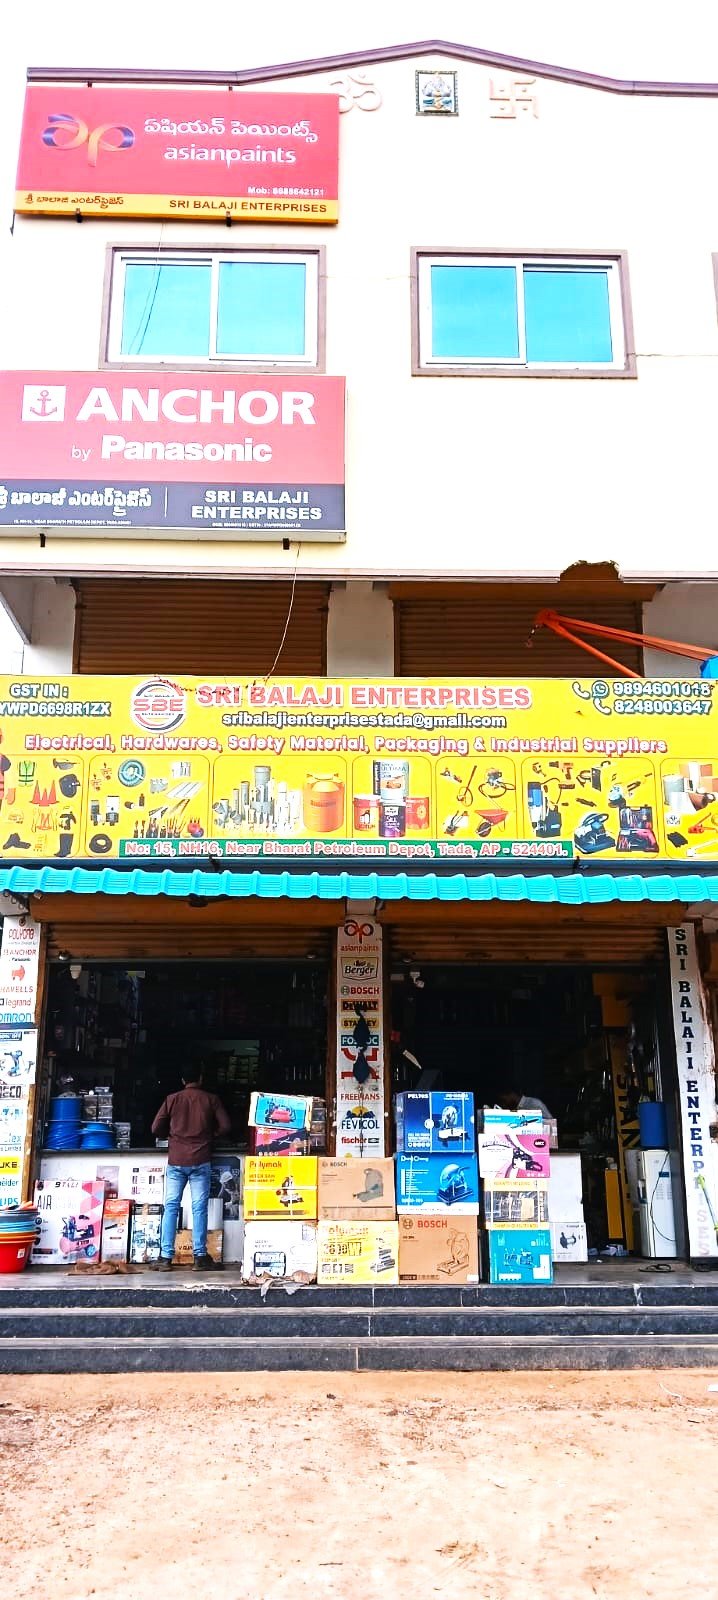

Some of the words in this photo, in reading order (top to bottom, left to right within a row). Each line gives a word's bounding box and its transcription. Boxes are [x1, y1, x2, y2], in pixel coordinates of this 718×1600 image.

[144, 117, 225, 136] ఏషియన్
[164, 143, 297, 168] asianpaints
[247, 186, 270, 195] Mob:
[169, 199, 190, 209] SRI
[193, 200, 238, 210] BALAJI
[241, 201, 327, 212] ENTERPRISES
[76, 387, 316, 425] ANCHOR
[70, 445, 92, 462] by
[100, 434, 273, 462] Panasonic
[204, 490, 236, 503] SRI
[242, 491, 309, 504] BALAJI
[191, 505, 322, 520] ENTERPRISES
[10, 683, 41, 698] GST
[42, 683, 60, 698] IN
[197, 685, 241, 705] SRI
[249, 686, 342, 706] BALAJI
[350, 686, 531, 707] ENTERPRISES
[133, 698, 184, 712] SBE
[614, 699, 713, 714] 8248003647
[222, 711, 507, 730] sribalajienterprisestada@gmail.com
[24, 734, 116, 753] Electrical,
[120, 734, 223, 753] Hardwares,
[227, 734, 285, 755] Safety
[289, 735, 370, 754] Material,
[374, 735, 469, 756] Packaging
[473, 737, 487, 752] &
[490, 736, 578, 753] Industrial
[582, 737, 668, 757] Suppliers
[125, 841, 149, 855] No:
[154, 841, 175, 857] 15,
[179, 841, 223, 857] NH16,
[226, 841, 260, 856] Near
[263, 842, 311, 856] Bharat
[313, 842, 386, 856] Petroleum
[389, 842, 435, 858] Depot,
[438, 842, 477, 858] Tada,
[480, 843, 500, 856] AP
[511, 843, 568, 857] 524401.
[675, 929, 688, 971] SRI
[345, 965, 375, 977] Berger
[350, 986, 380, 995] BOSCH
[341, 1119, 380, 1130] FEVICOL
[37, 1194, 52, 1210] AIR
[417, 1220, 448, 1228] BOSCH
